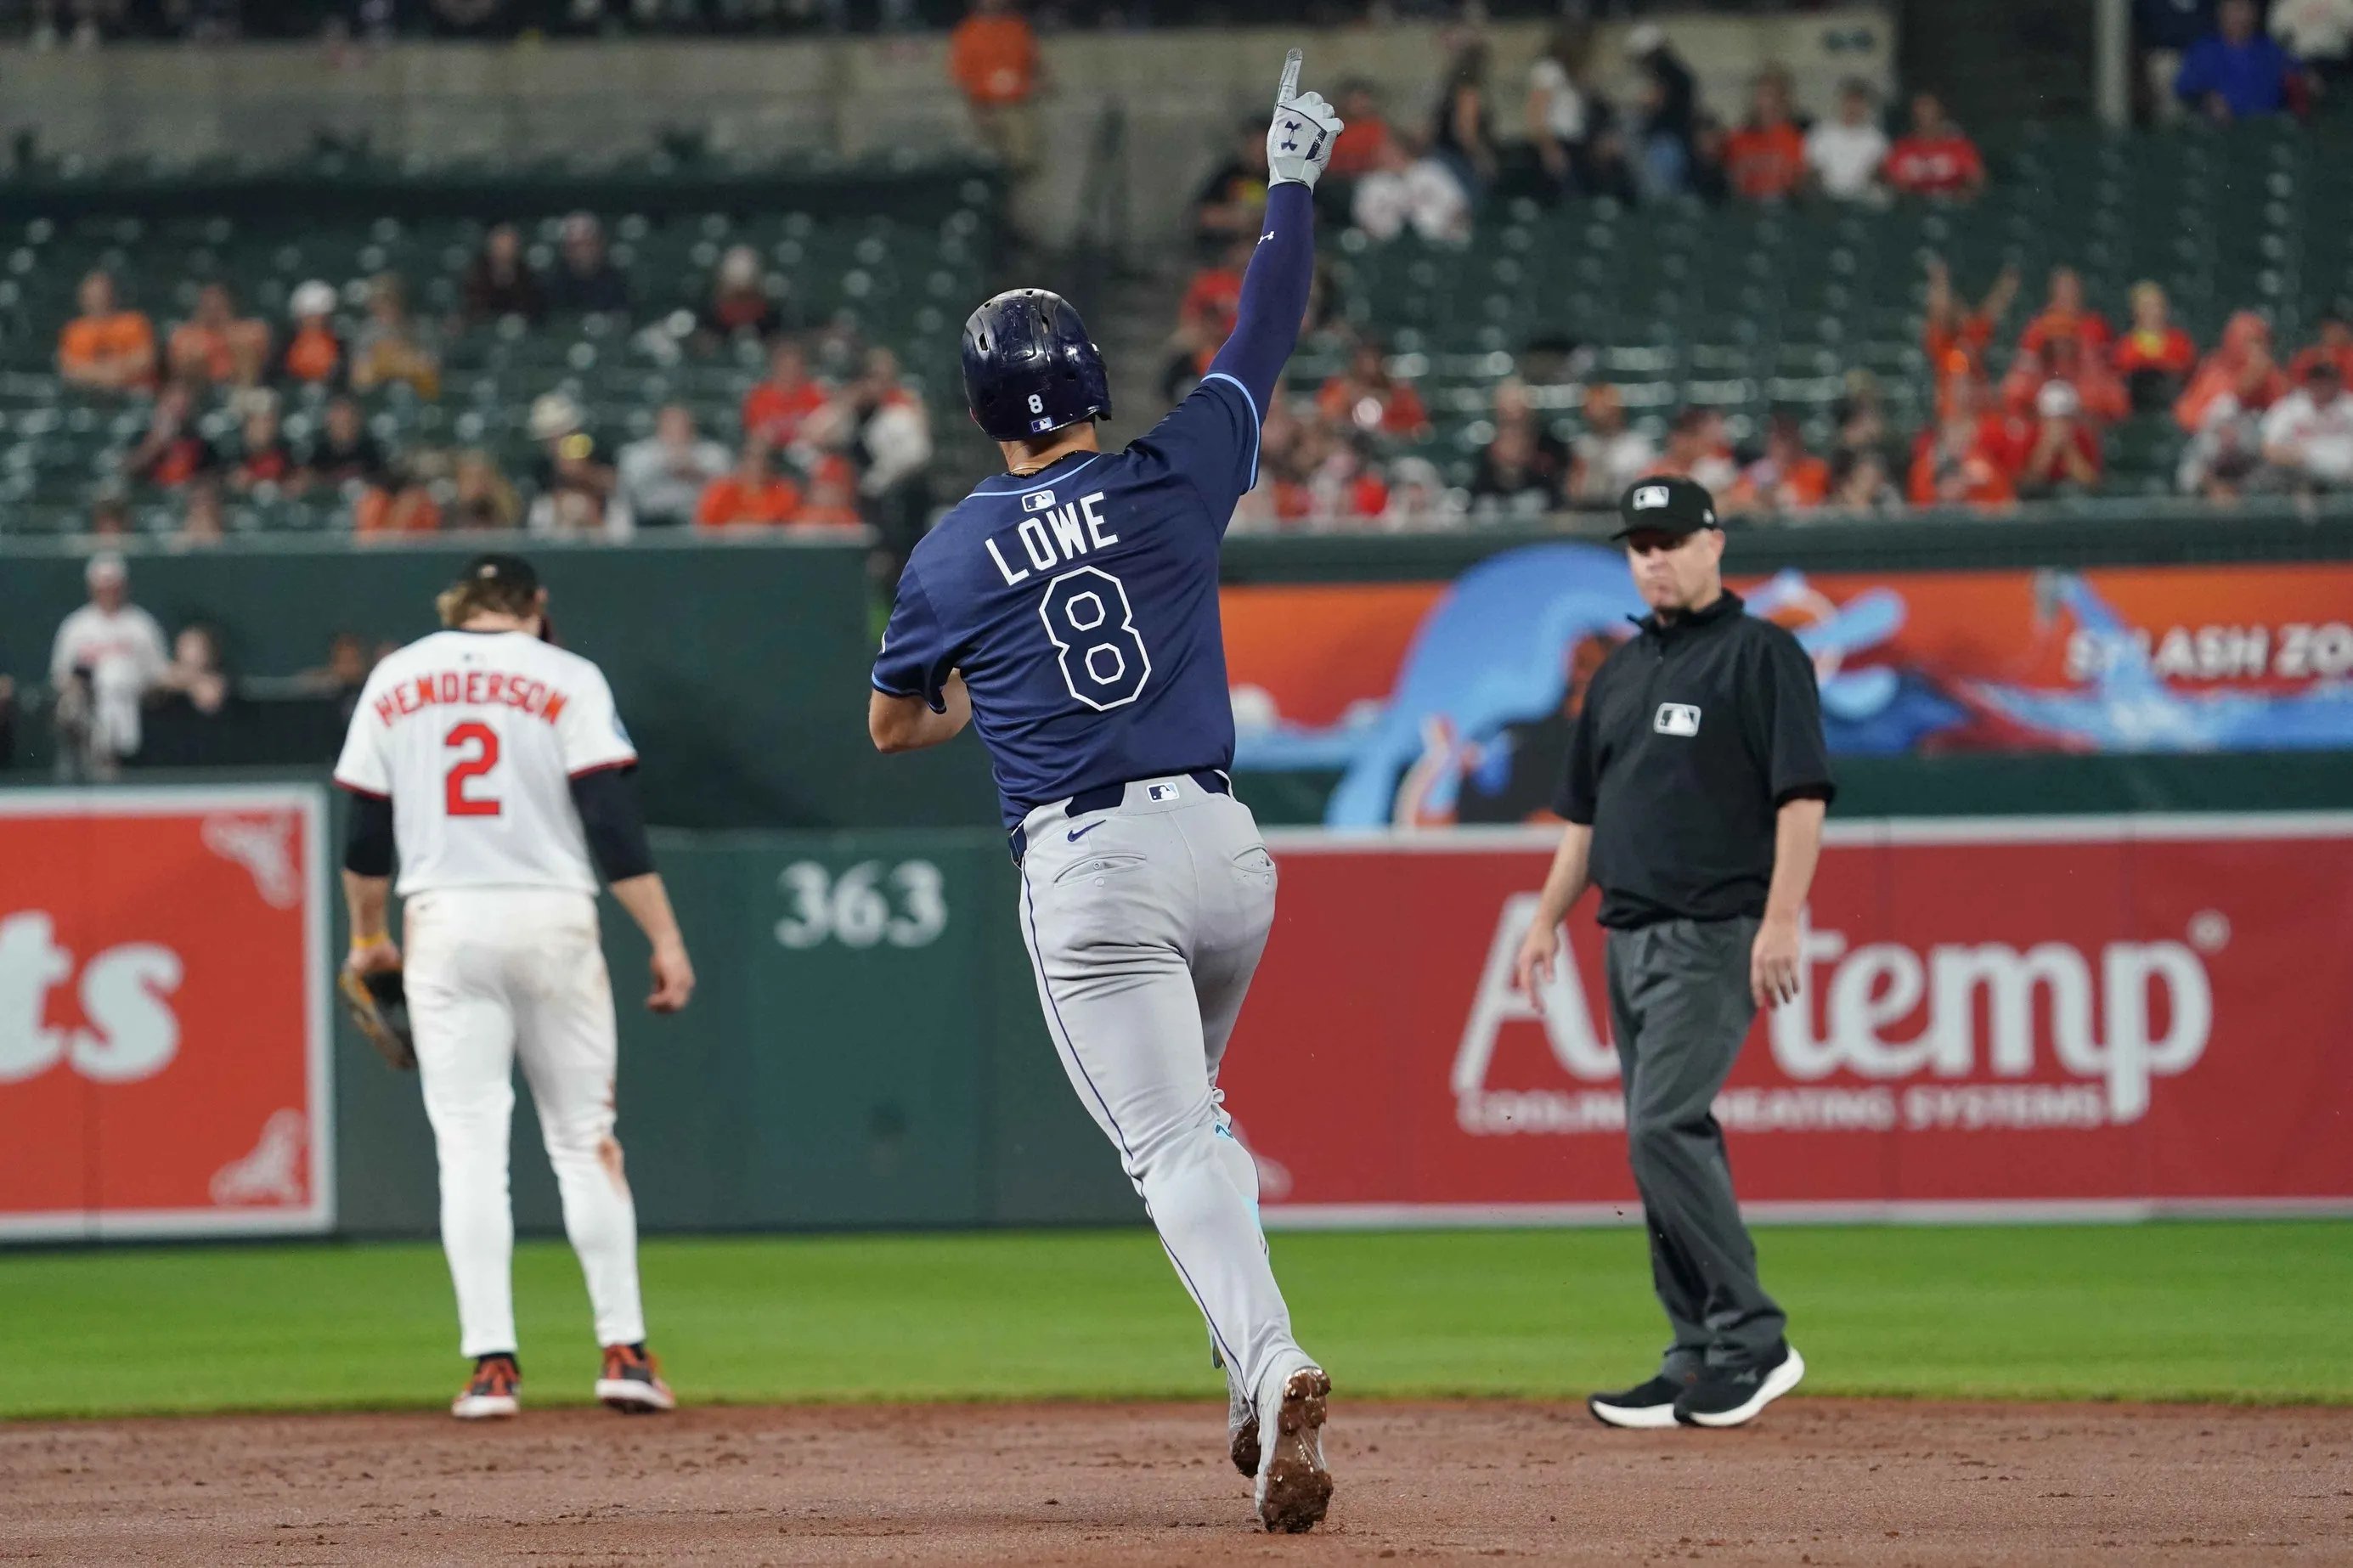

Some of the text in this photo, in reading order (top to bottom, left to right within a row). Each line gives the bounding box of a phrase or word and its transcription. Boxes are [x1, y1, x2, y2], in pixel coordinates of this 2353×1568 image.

[1027, 393, 1044, 415] 8
[984, 489, 1120, 587] LOWE
[1038, 565, 1152, 712] 8
[373, 670, 570, 730] HENDERSON
[443, 719, 502, 816] 2
[773, 858, 949, 950] 363
[0, 908, 183, 1084] ts
[1903, 1083, 2103, 1130] SYSTEMS
